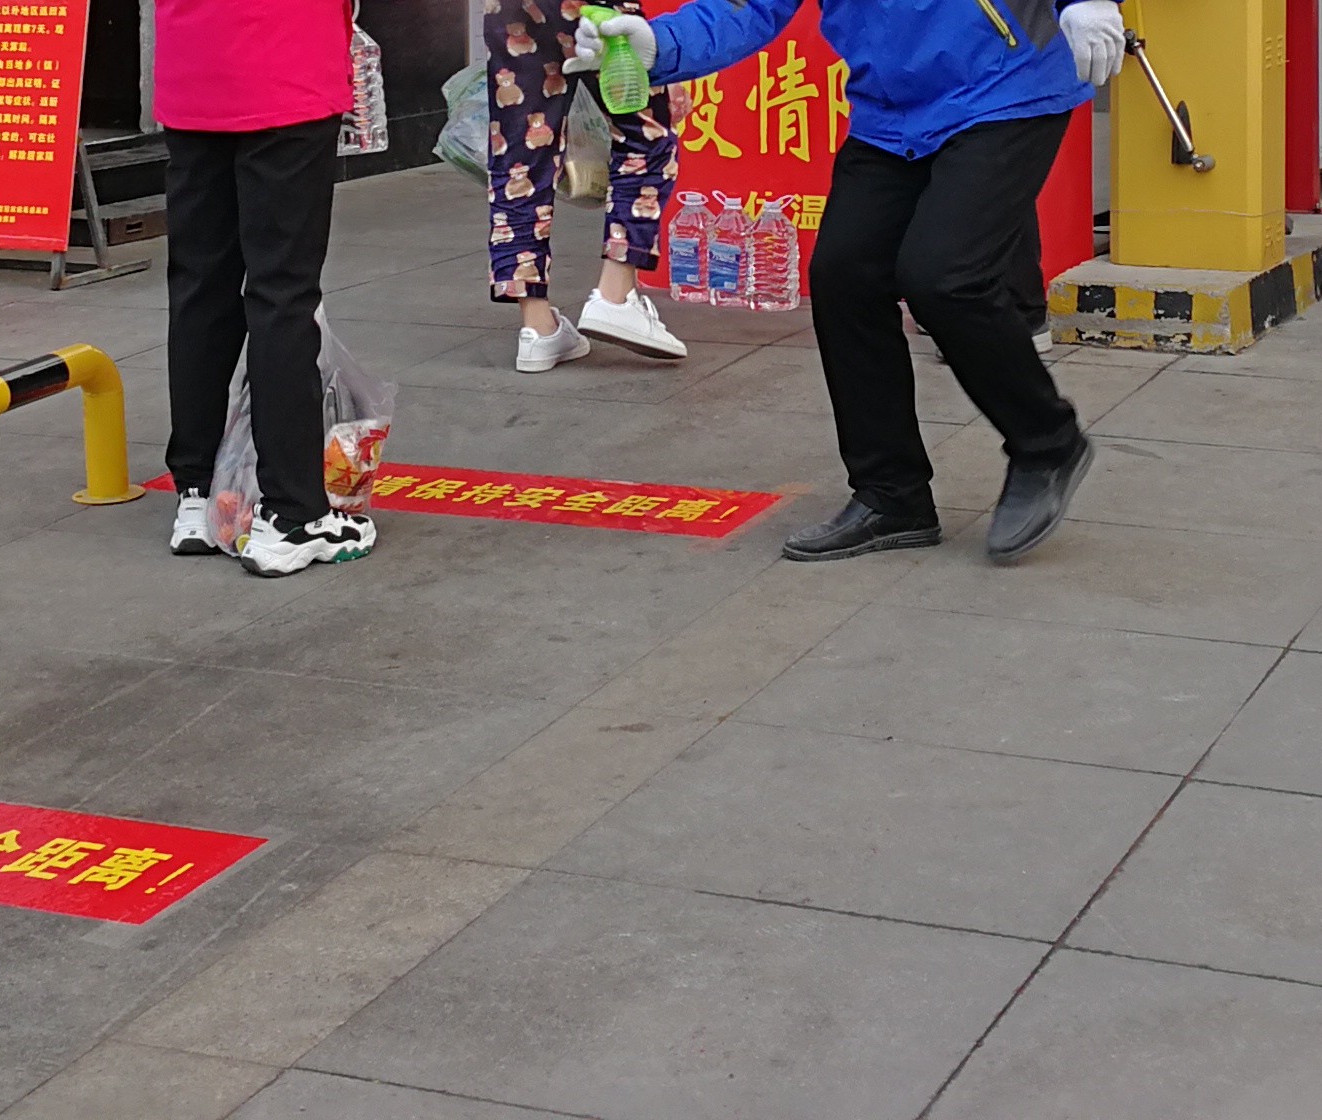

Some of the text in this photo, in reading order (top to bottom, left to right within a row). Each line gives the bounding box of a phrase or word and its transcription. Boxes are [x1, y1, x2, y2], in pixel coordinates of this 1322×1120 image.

[371, 474, 741, 525] 请保持安全距离!
